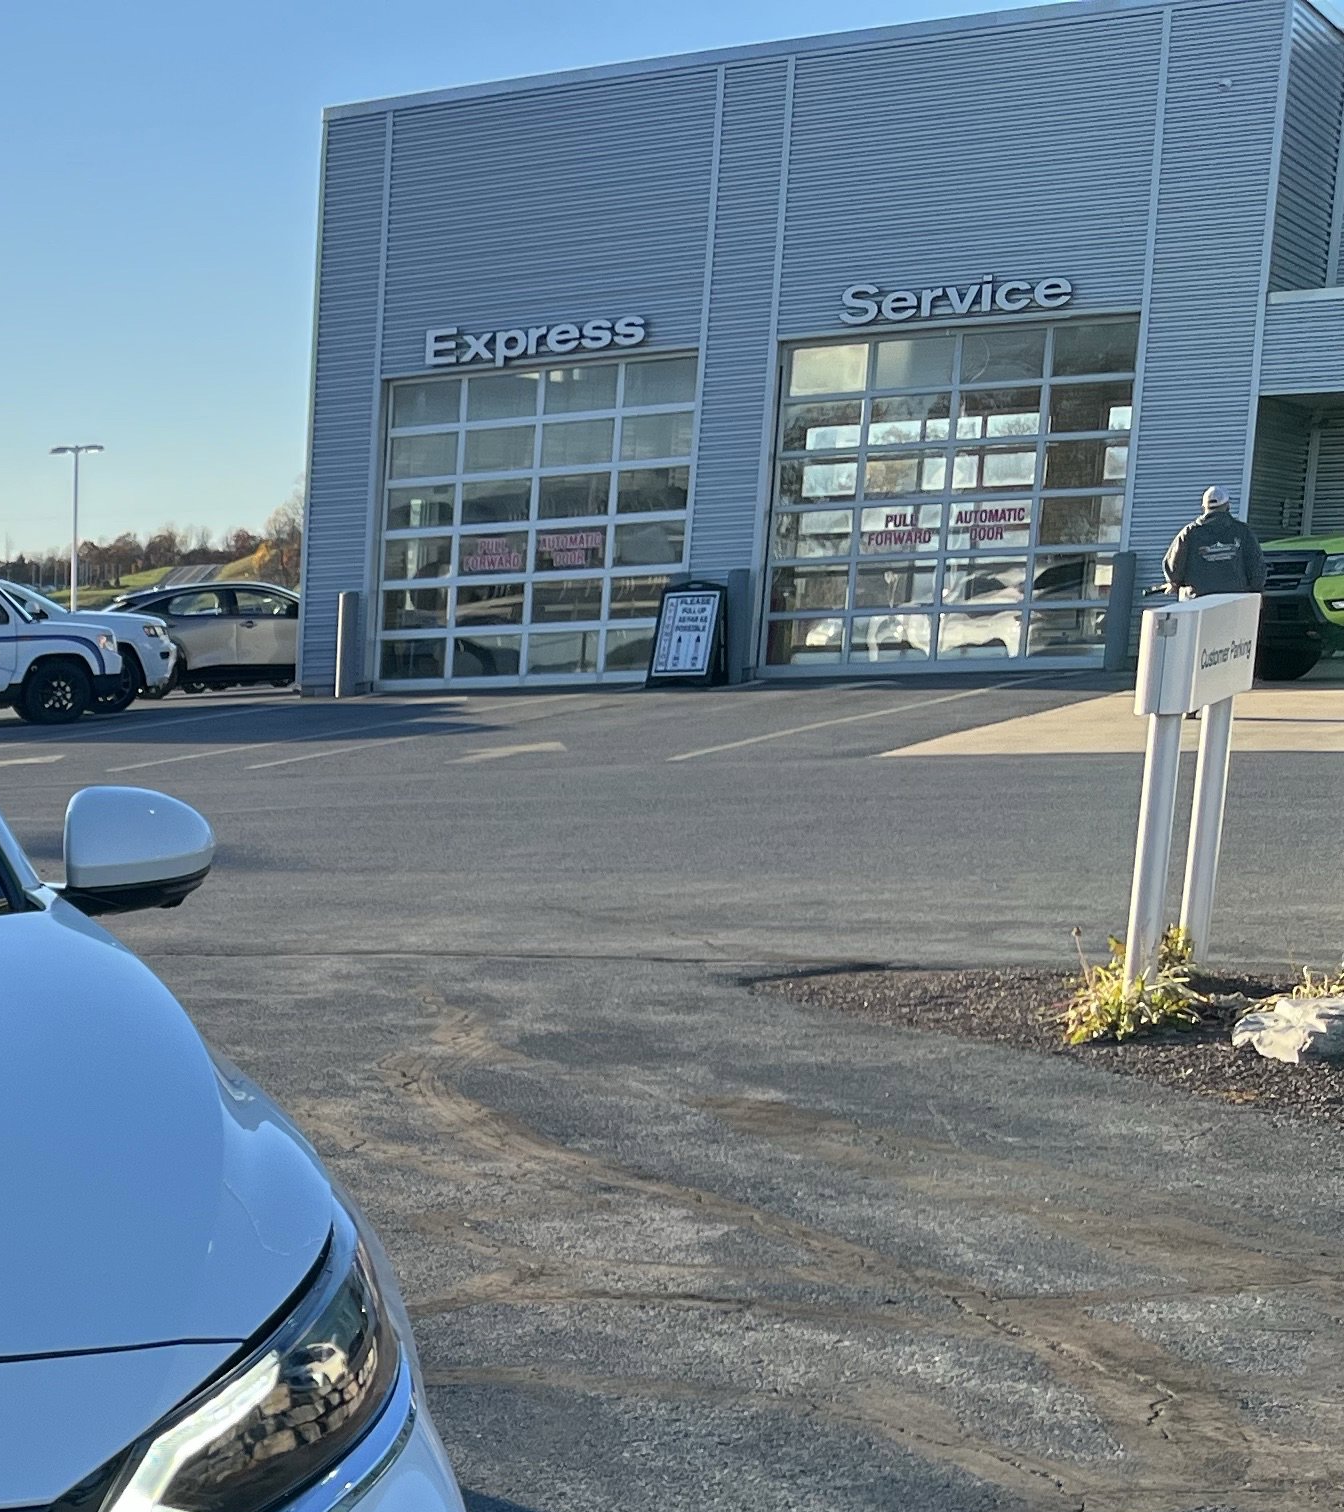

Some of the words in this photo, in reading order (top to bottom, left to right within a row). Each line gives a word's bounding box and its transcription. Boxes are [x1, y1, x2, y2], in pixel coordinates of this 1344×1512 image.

[838, 273, 1073, 325] Service
[424, 315, 646, 367] Express
[885, 513, 918, 529] PULL
[955, 507, 1026, 525] AUTOMATIC
[539, 532, 602, 551] AUTOMATIC
[867, 530, 933, 546] FORWARD
[970, 526, 1004, 542] DOOR
[478, 538, 509, 555] PULL
[463, 553, 523, 571] FORWARD
[553, 550, 585, 567] DOOR
[1200, 647, 1230, 669] Customer
[1230, 639, 1252, 660] Parking
